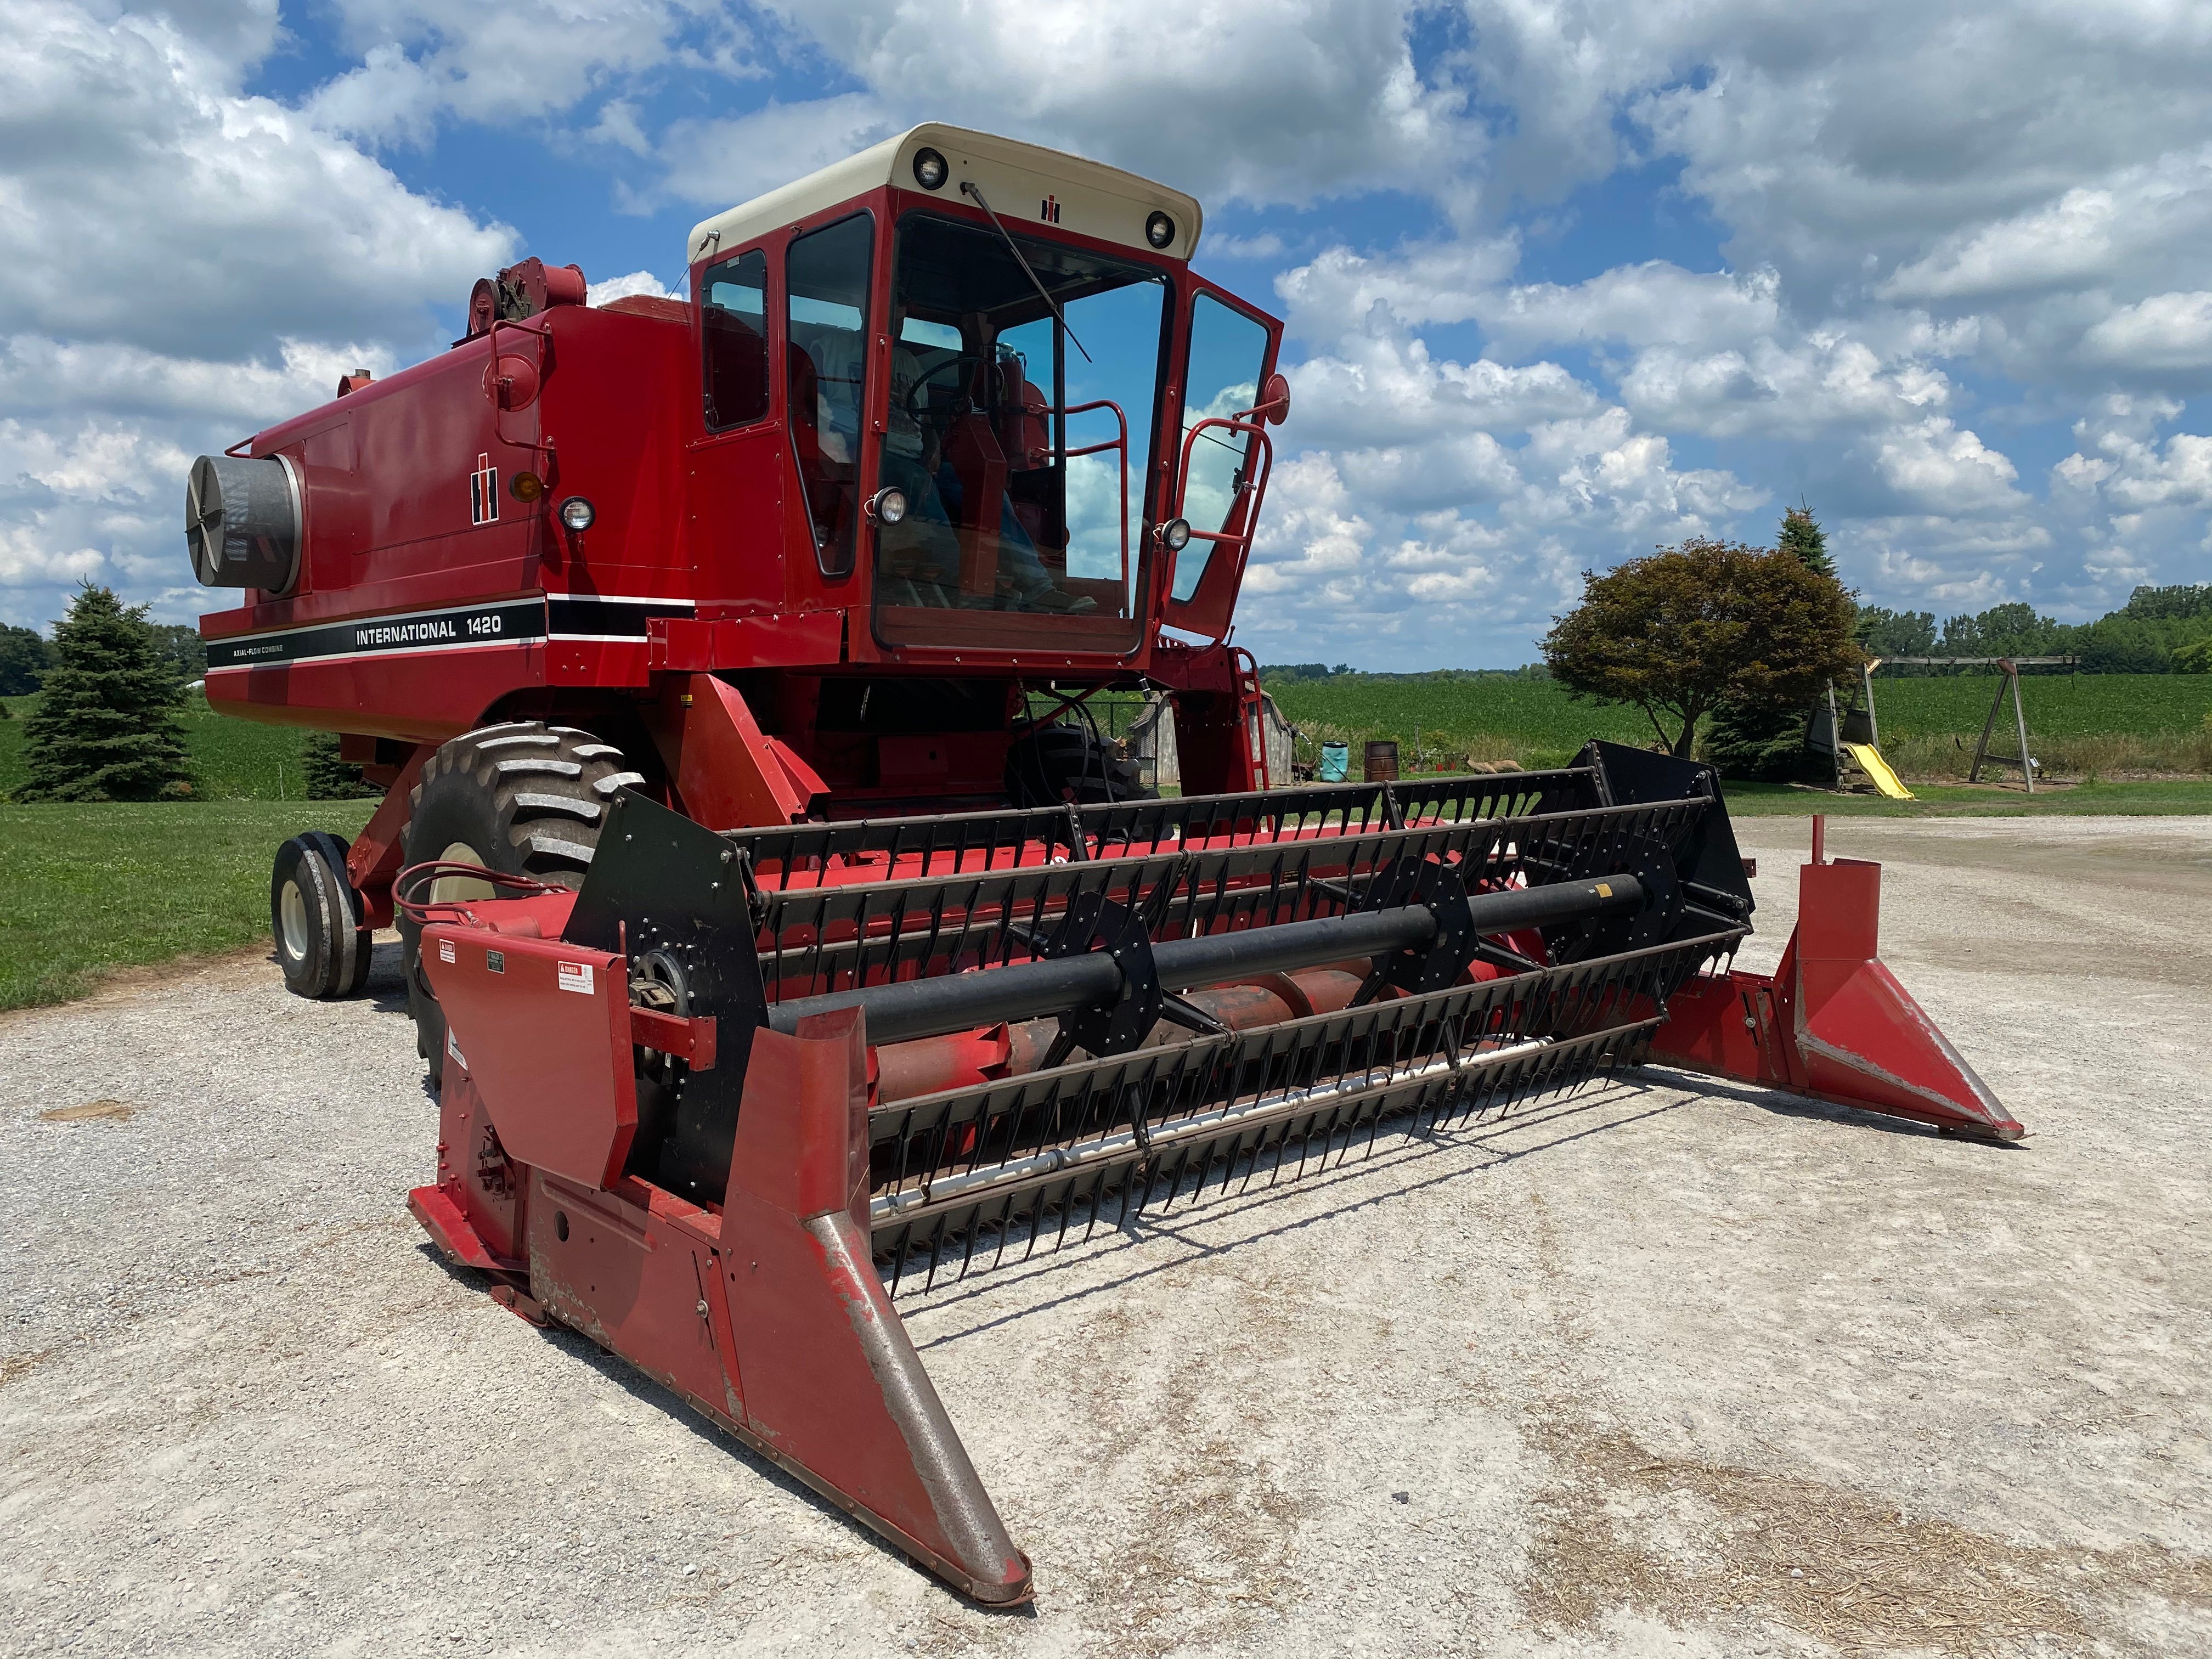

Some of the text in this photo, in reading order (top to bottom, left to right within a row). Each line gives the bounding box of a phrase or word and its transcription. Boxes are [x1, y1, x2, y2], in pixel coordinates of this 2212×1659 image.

[356, 615, 501, 645] INTERNATIONAL 1420
[233, 645, 283, 657] AXIAL-FLOW COMBINE
[565, 966, 578, 974] DANGER
